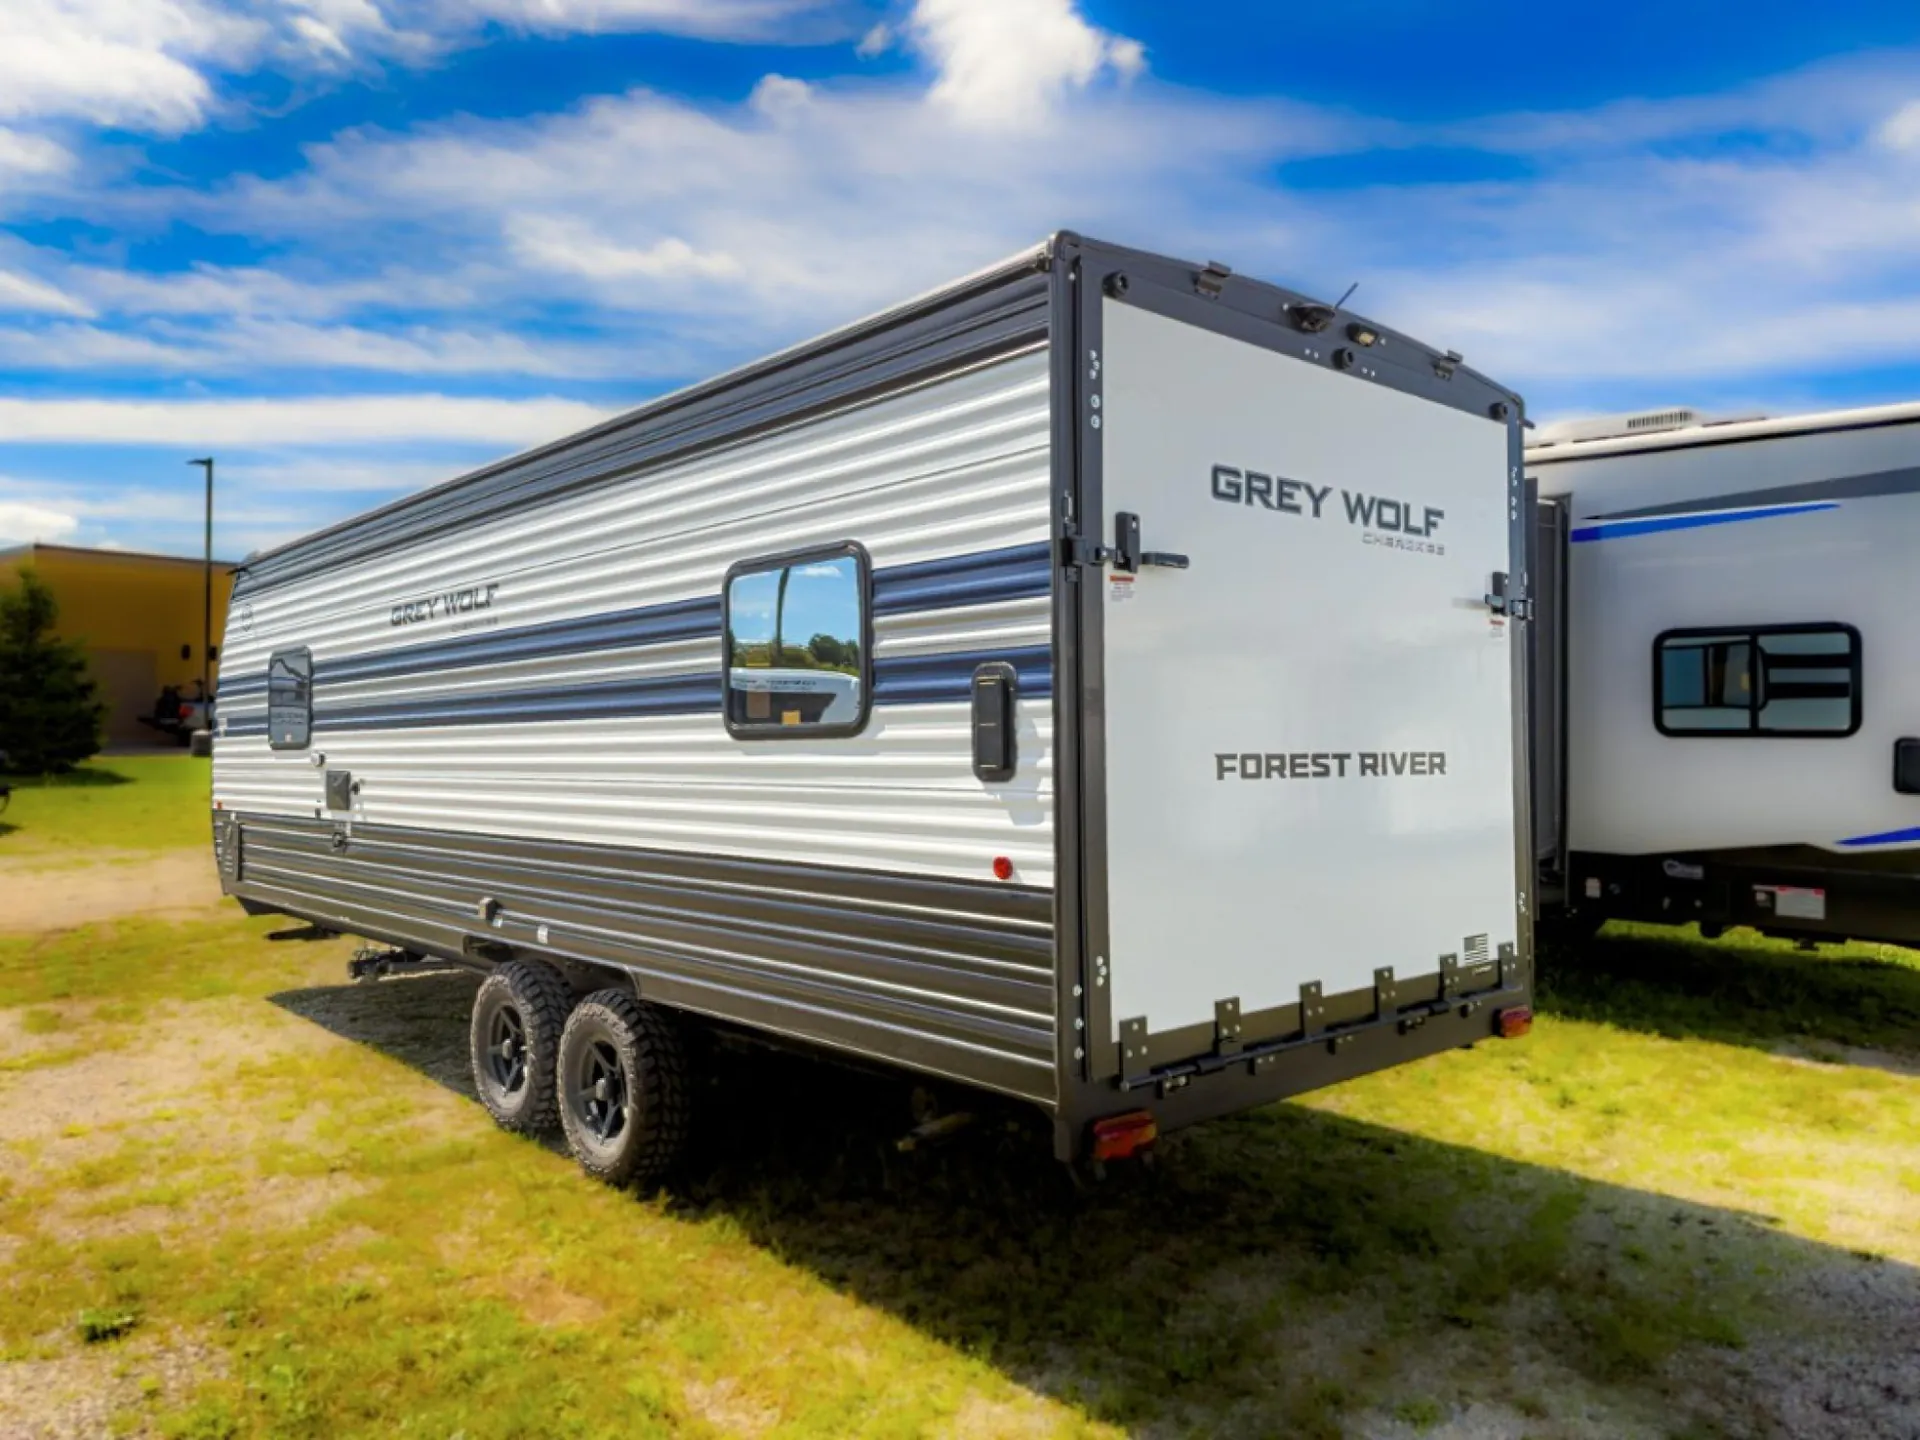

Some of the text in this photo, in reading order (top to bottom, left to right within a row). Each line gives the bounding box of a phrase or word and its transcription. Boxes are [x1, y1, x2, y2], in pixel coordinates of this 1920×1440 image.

[1210, 463, 1445, 537] GREY WOLF
[391, 596, 439, 626] GREY
[442, 583, 499, 615] WOLF
[1214, 751, 1447, 780] FOREST RIVER
